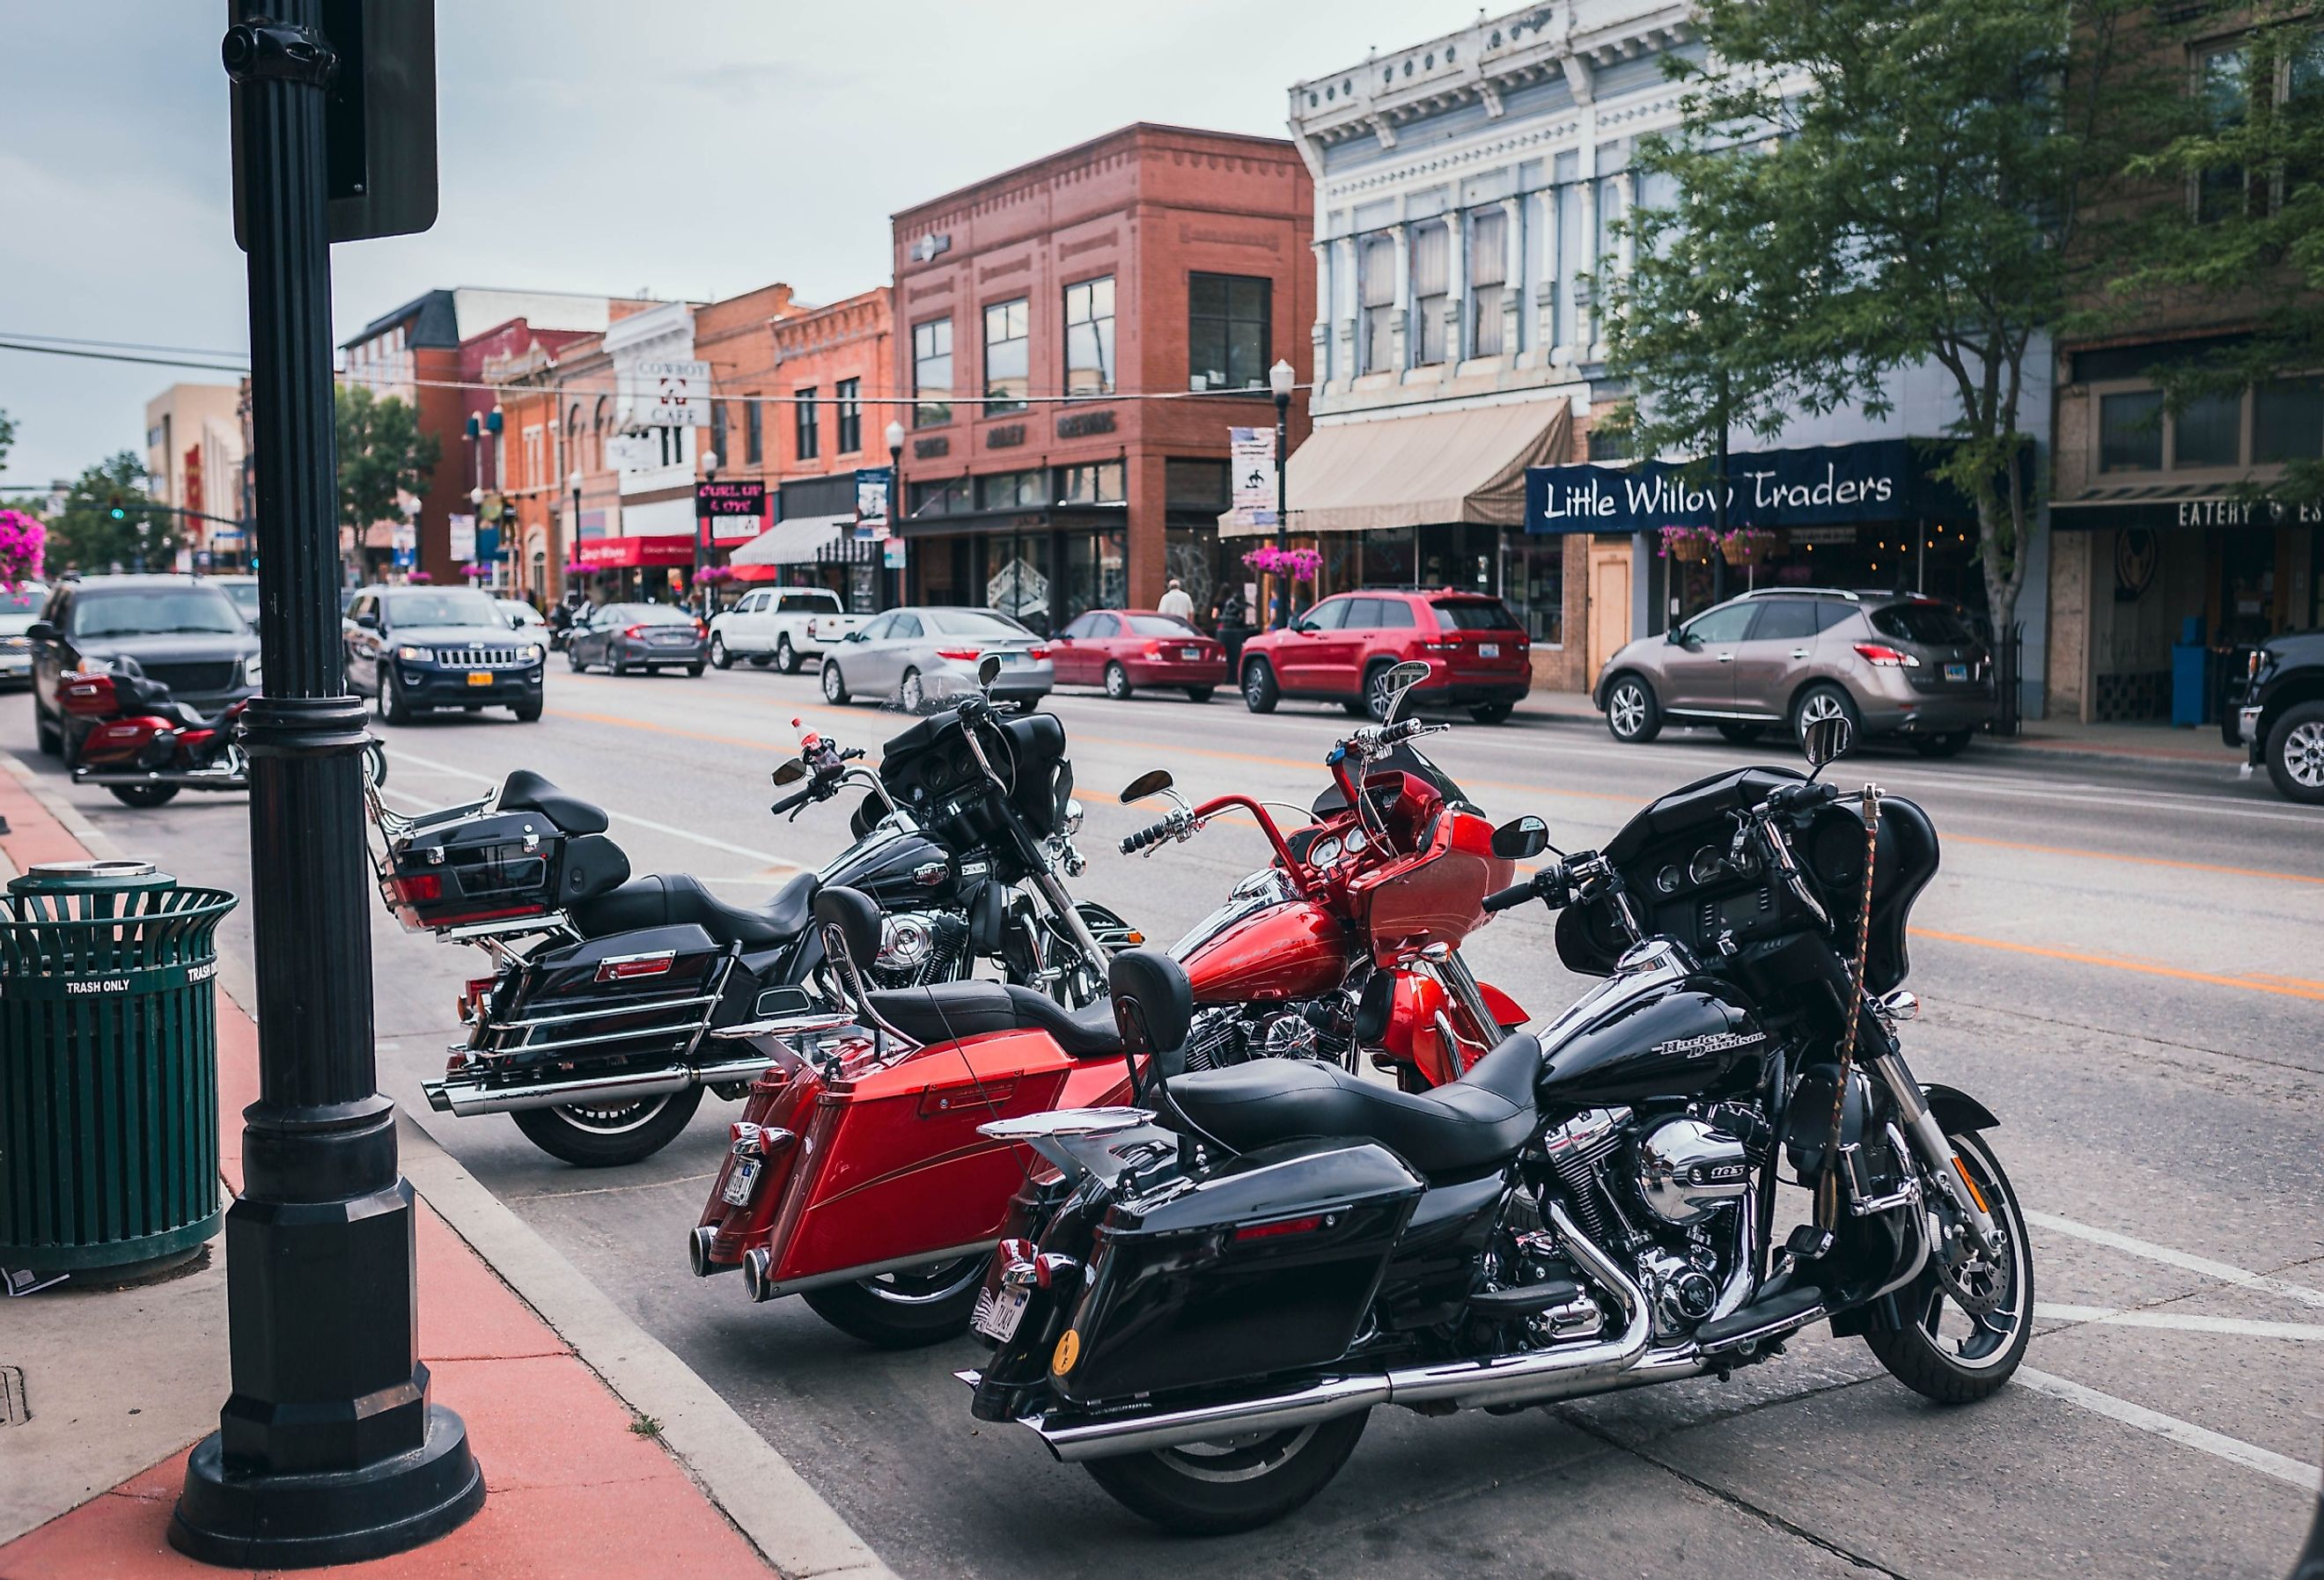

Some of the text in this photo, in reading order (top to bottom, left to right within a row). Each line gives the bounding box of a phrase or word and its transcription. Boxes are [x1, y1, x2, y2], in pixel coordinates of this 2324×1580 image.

[651, 408, 696, 423] CAFE
[1544, 478, 1617, 518] Little
[1744, 462, 1892, 509] Traders
[188, 963, 210, 982] TRASH
[66, 979, 130, 994] TRASH ONLY
[1711, 1165, 1746, 1179] 103
